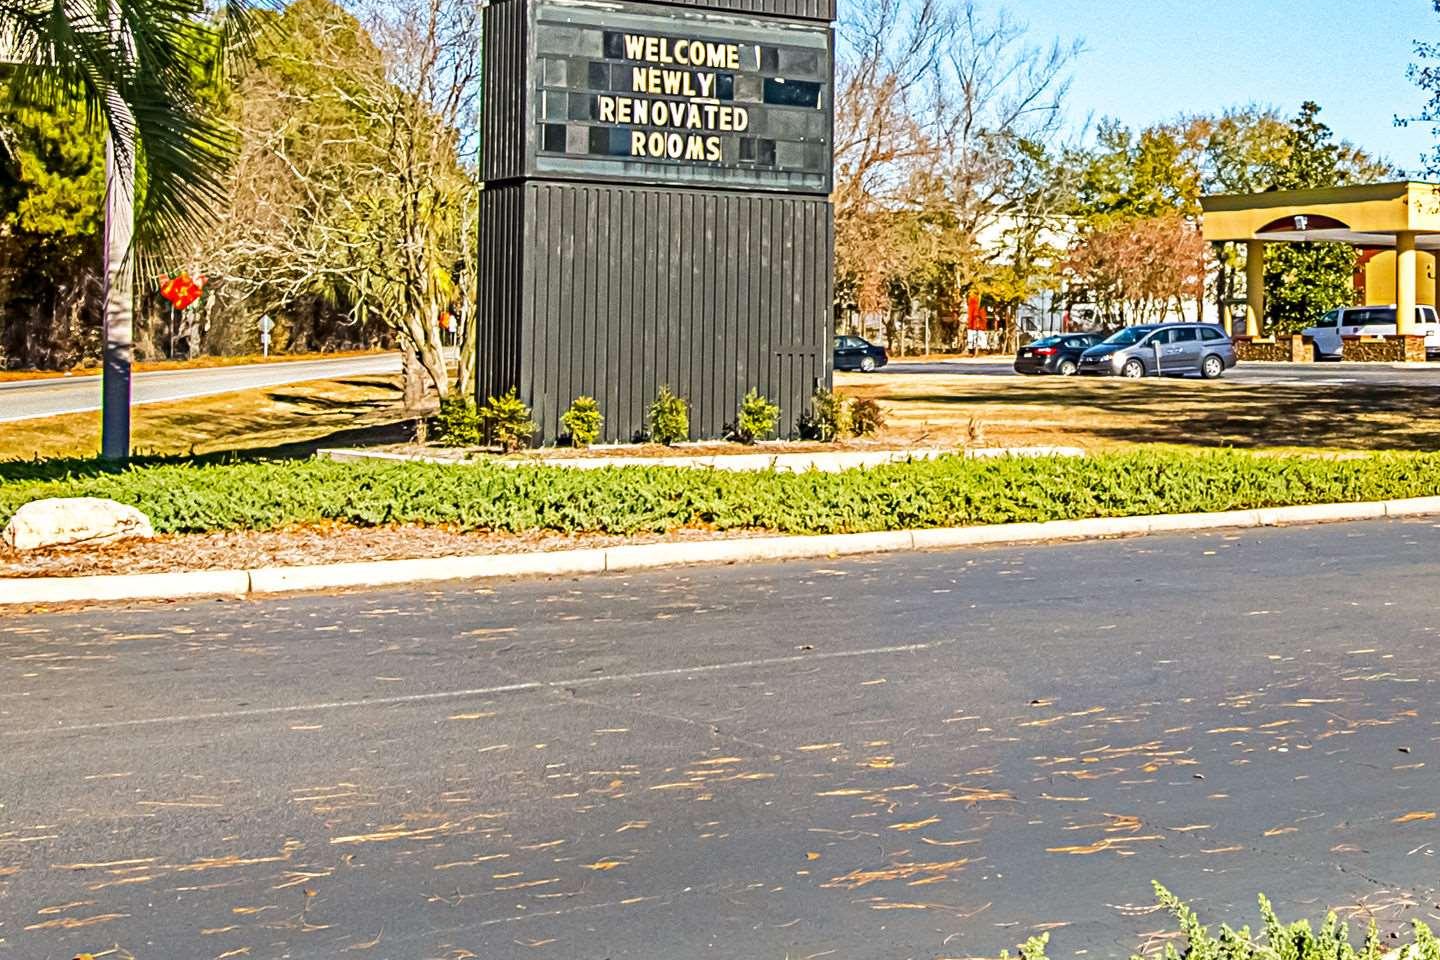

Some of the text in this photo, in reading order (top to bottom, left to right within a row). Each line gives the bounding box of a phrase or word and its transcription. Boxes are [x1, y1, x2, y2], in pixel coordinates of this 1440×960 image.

[624, 35, 739, 69] WELCOME
[632, 68, 715, 98] NEWLY
[600, 97, 748, 131] RENOVATED
[632, 132, 721, 161] ROOMS
